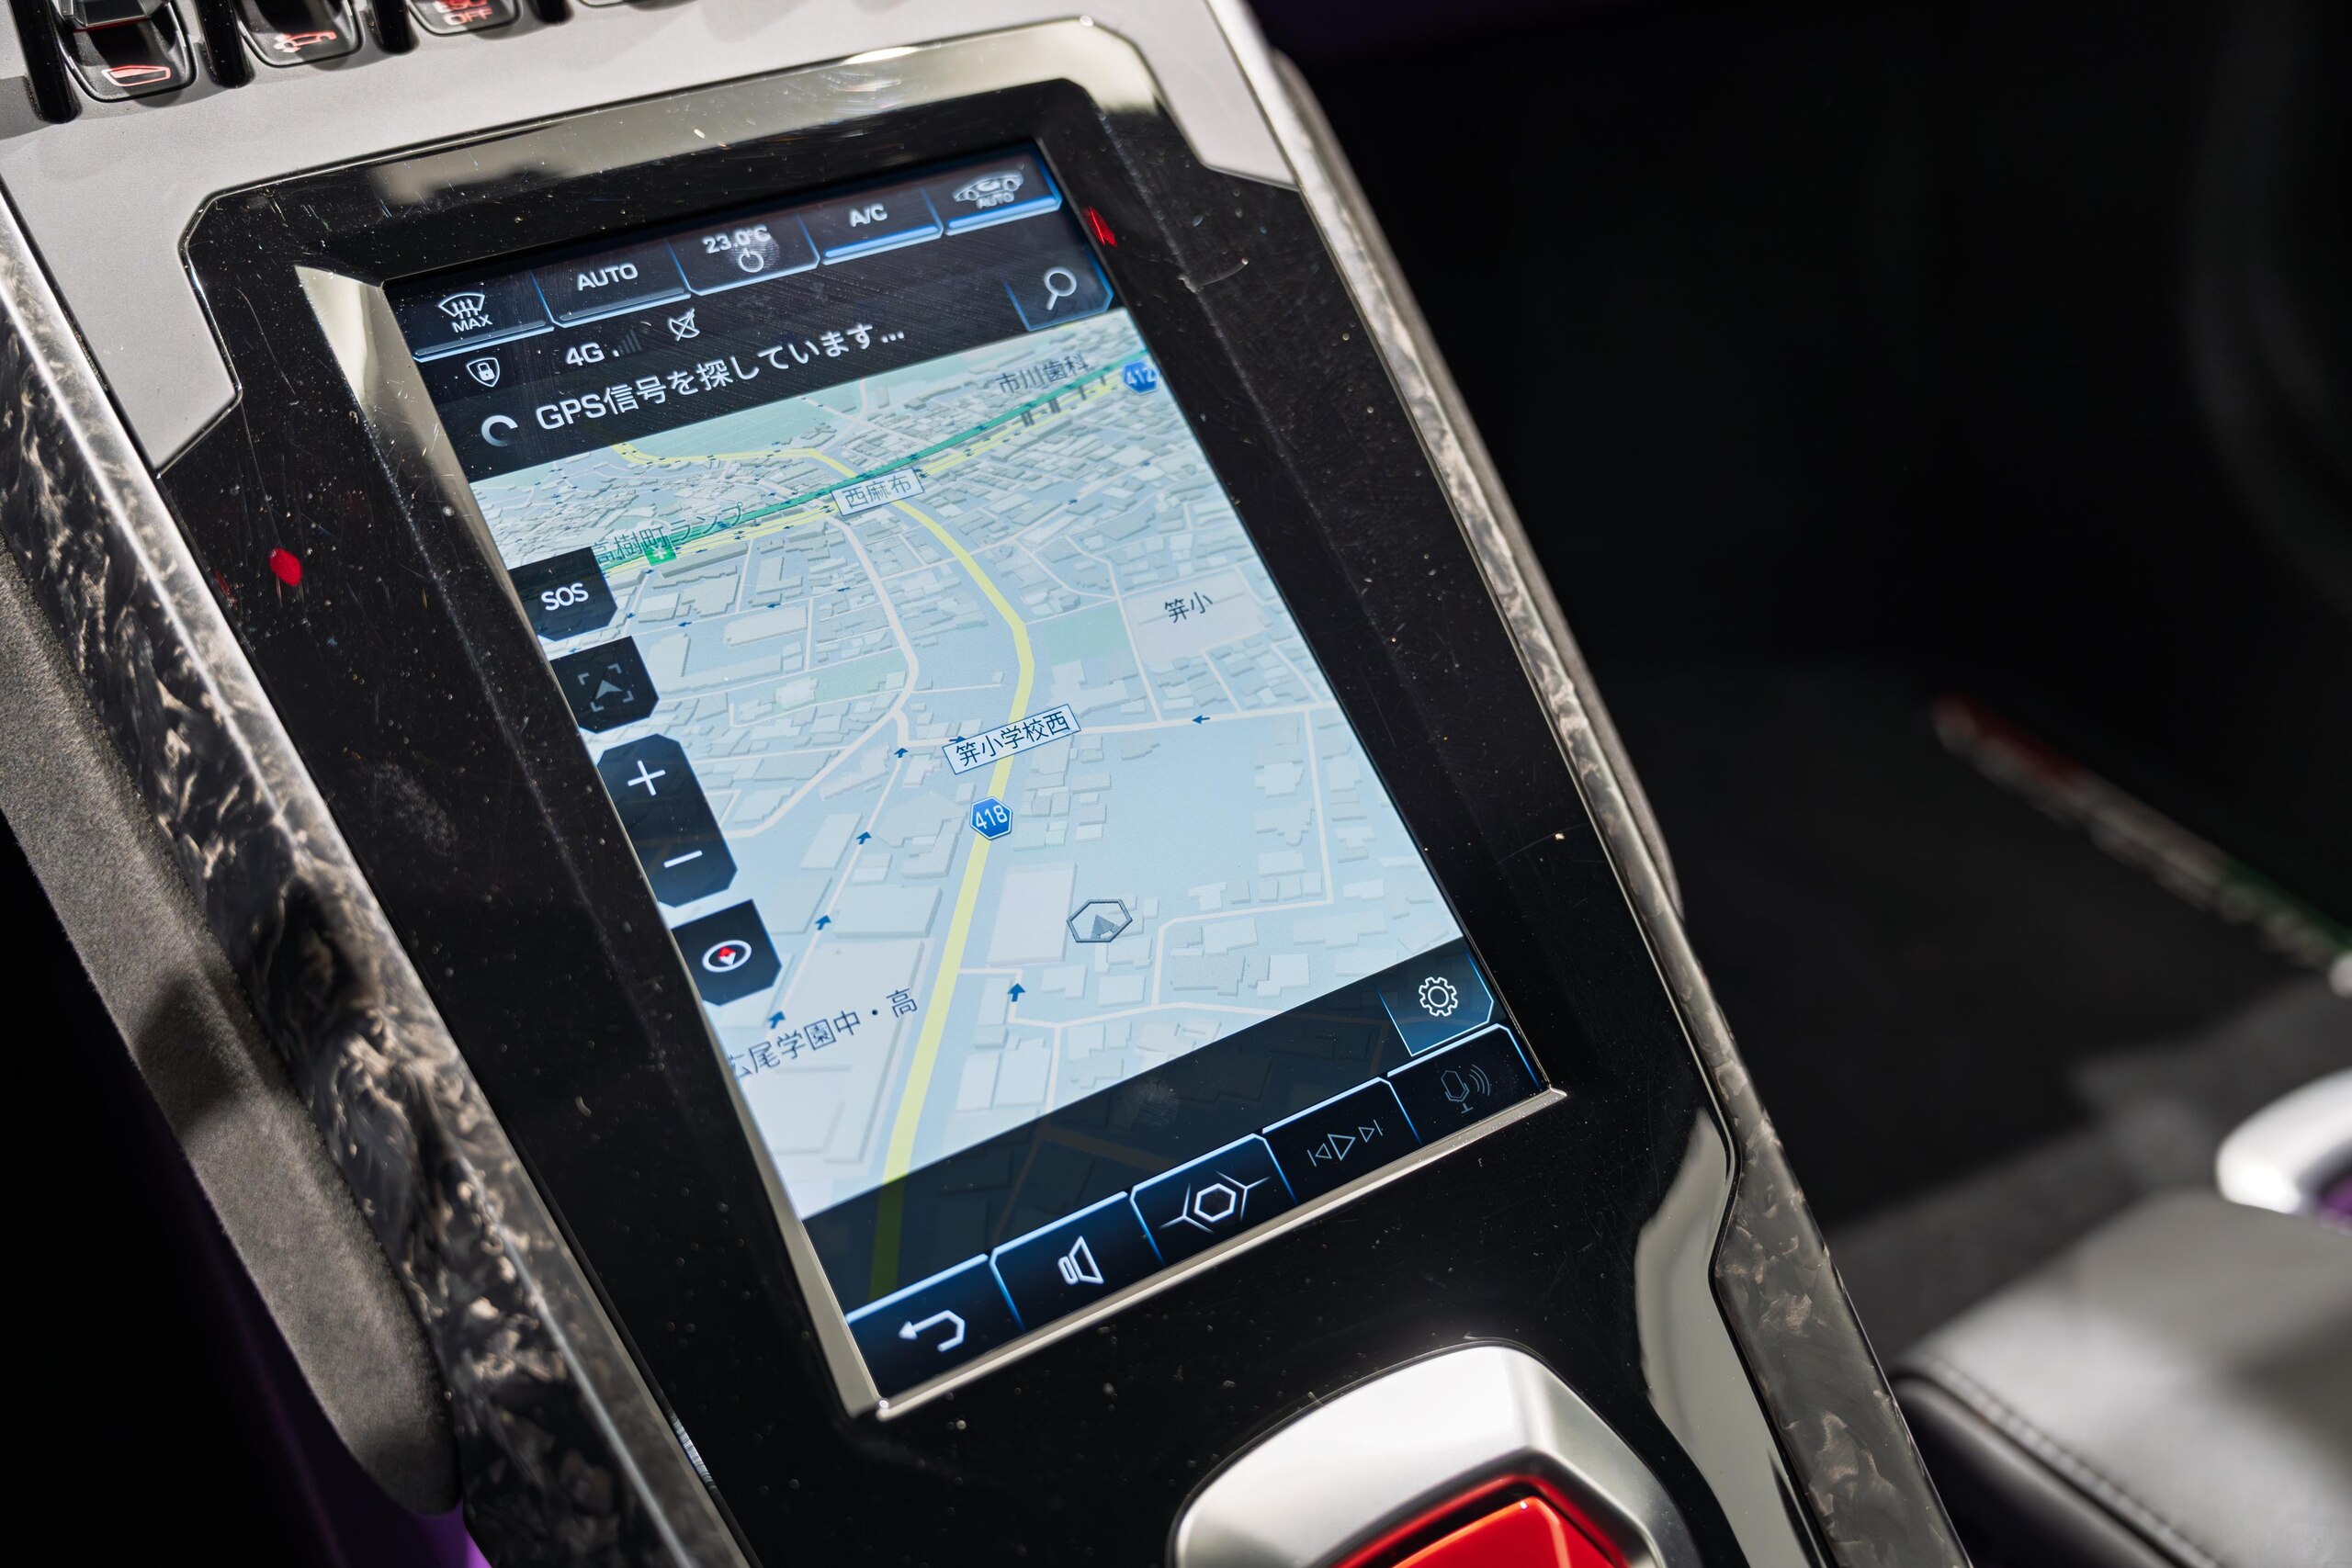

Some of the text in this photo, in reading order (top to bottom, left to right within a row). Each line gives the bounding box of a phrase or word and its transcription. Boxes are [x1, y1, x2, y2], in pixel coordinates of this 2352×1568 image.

[849, 203, 888, 228] A/C
[577, 263, 639, 291] AUTO
[451, 314, 493, 333] MAX
[565, 342, 605, 367] 4G
[995, 352, 1089, 394] 市川歯科
[842, 475, 912, 510] 西麻布
[591, 501, 744, 564] 高樹町ランプ
[540, 581, 589, 612] SOS
[1163, 591, 1214, 624] 笄小
[955, 710, 1071, 767] 笄小学校西
[974, 805, 1008, 830] 418
